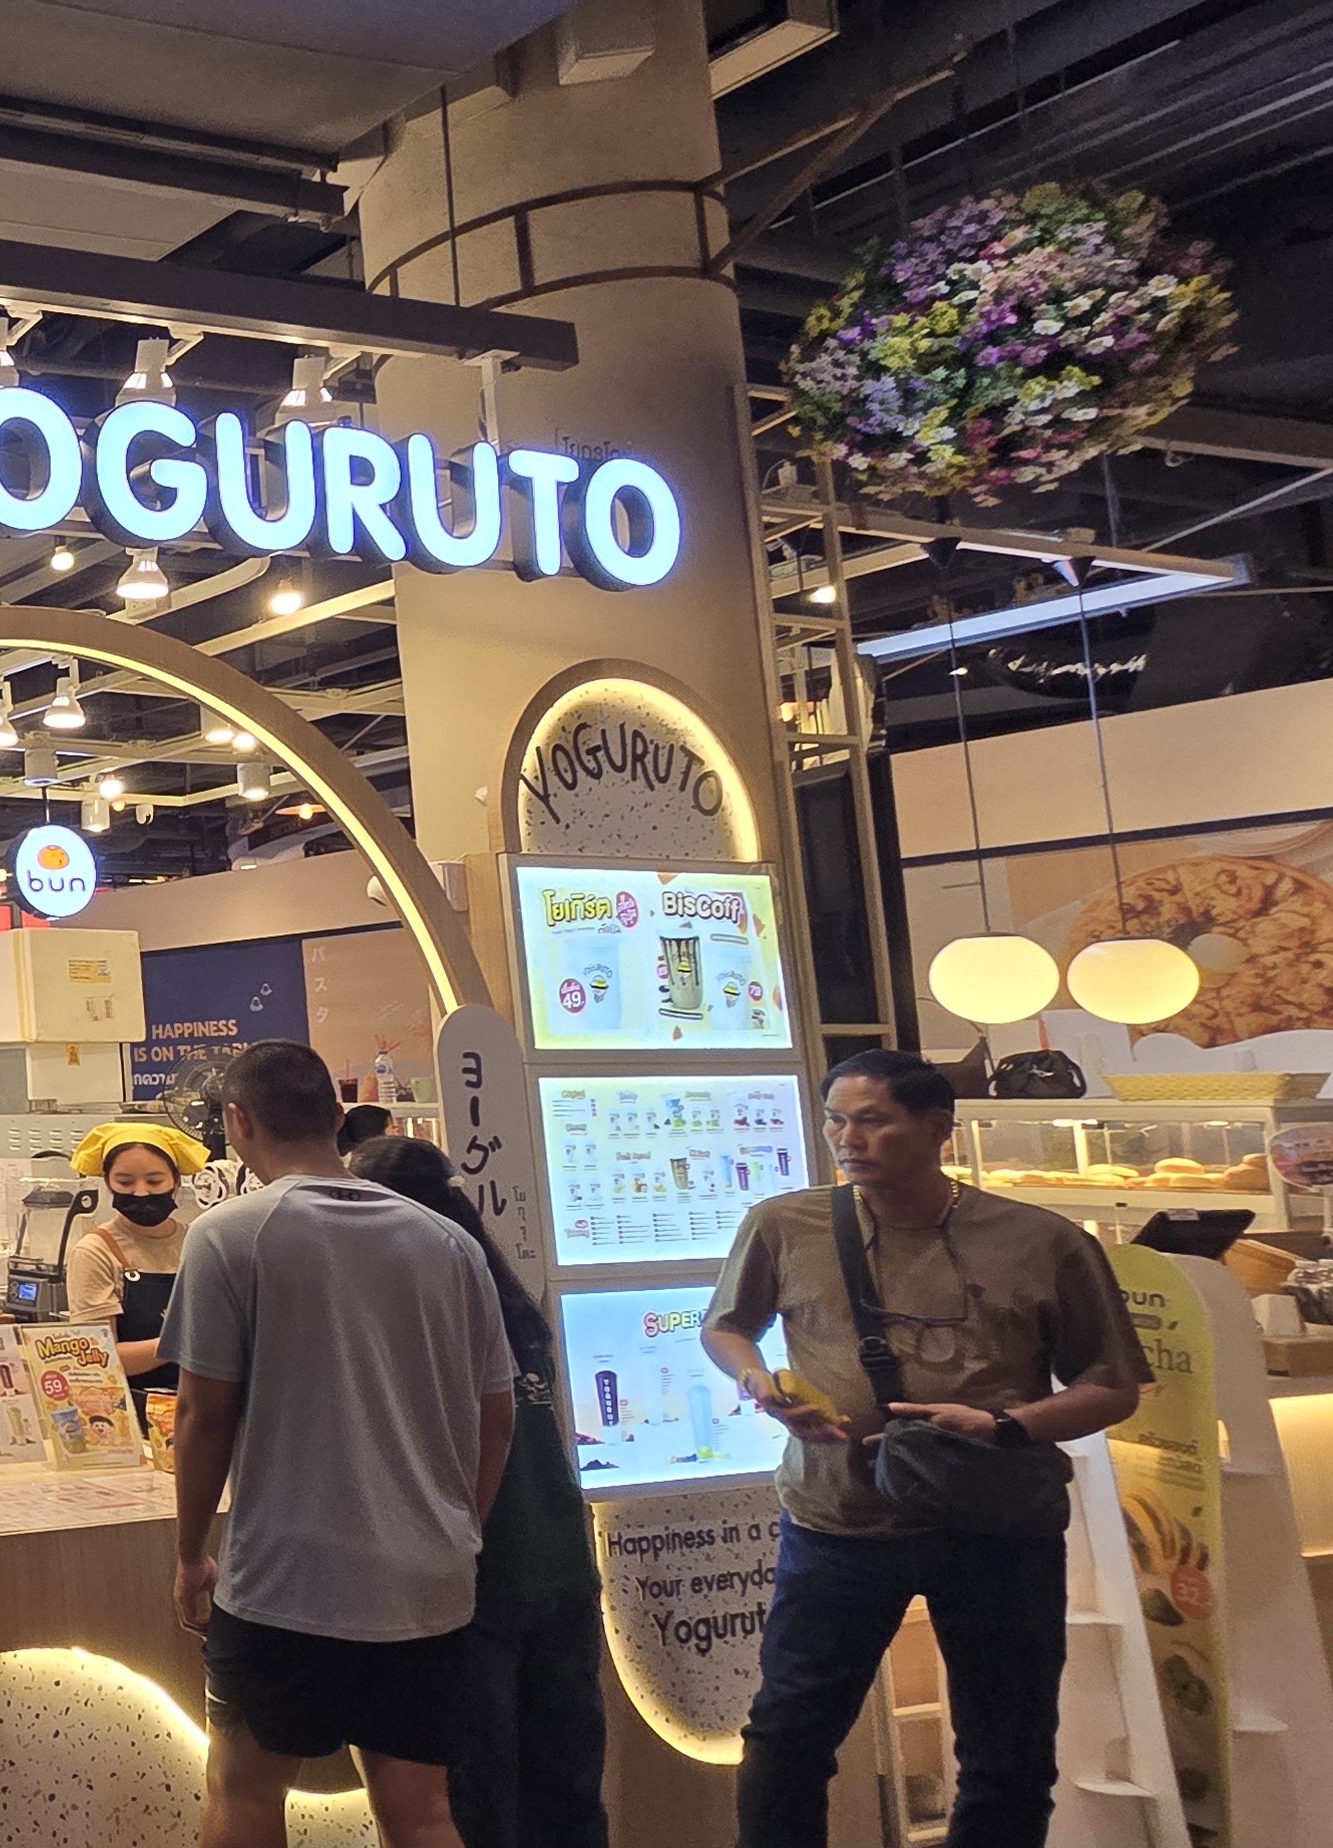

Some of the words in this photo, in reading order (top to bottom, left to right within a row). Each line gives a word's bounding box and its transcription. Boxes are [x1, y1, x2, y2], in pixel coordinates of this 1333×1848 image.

[520, 721, 724, 825] YOGURUTO
[26, 870, 87, 896] bun
[151, 1019, 238, 1040] HAPPINESS
[134, 1047, 147, 1062] IS
[151, 1046, 174, 1062] ON
[460, 1051, 508, 1217] ヨーグル
[643, 1309, 707, 1338] SUPER
[35, 1335, 90, 1361] Mango
[76, 1347, 110, 1369] Jelly
[605, 1525, 716, 1563] Happiness
[721, 1519, 741, 1544] in
[747, 1521, 761, 1541] a
[634, 1574, 684, 1601] Your
[690, 1559, 776, 1595] everyda
[651, 1602, 766, 1657] Yogurut
